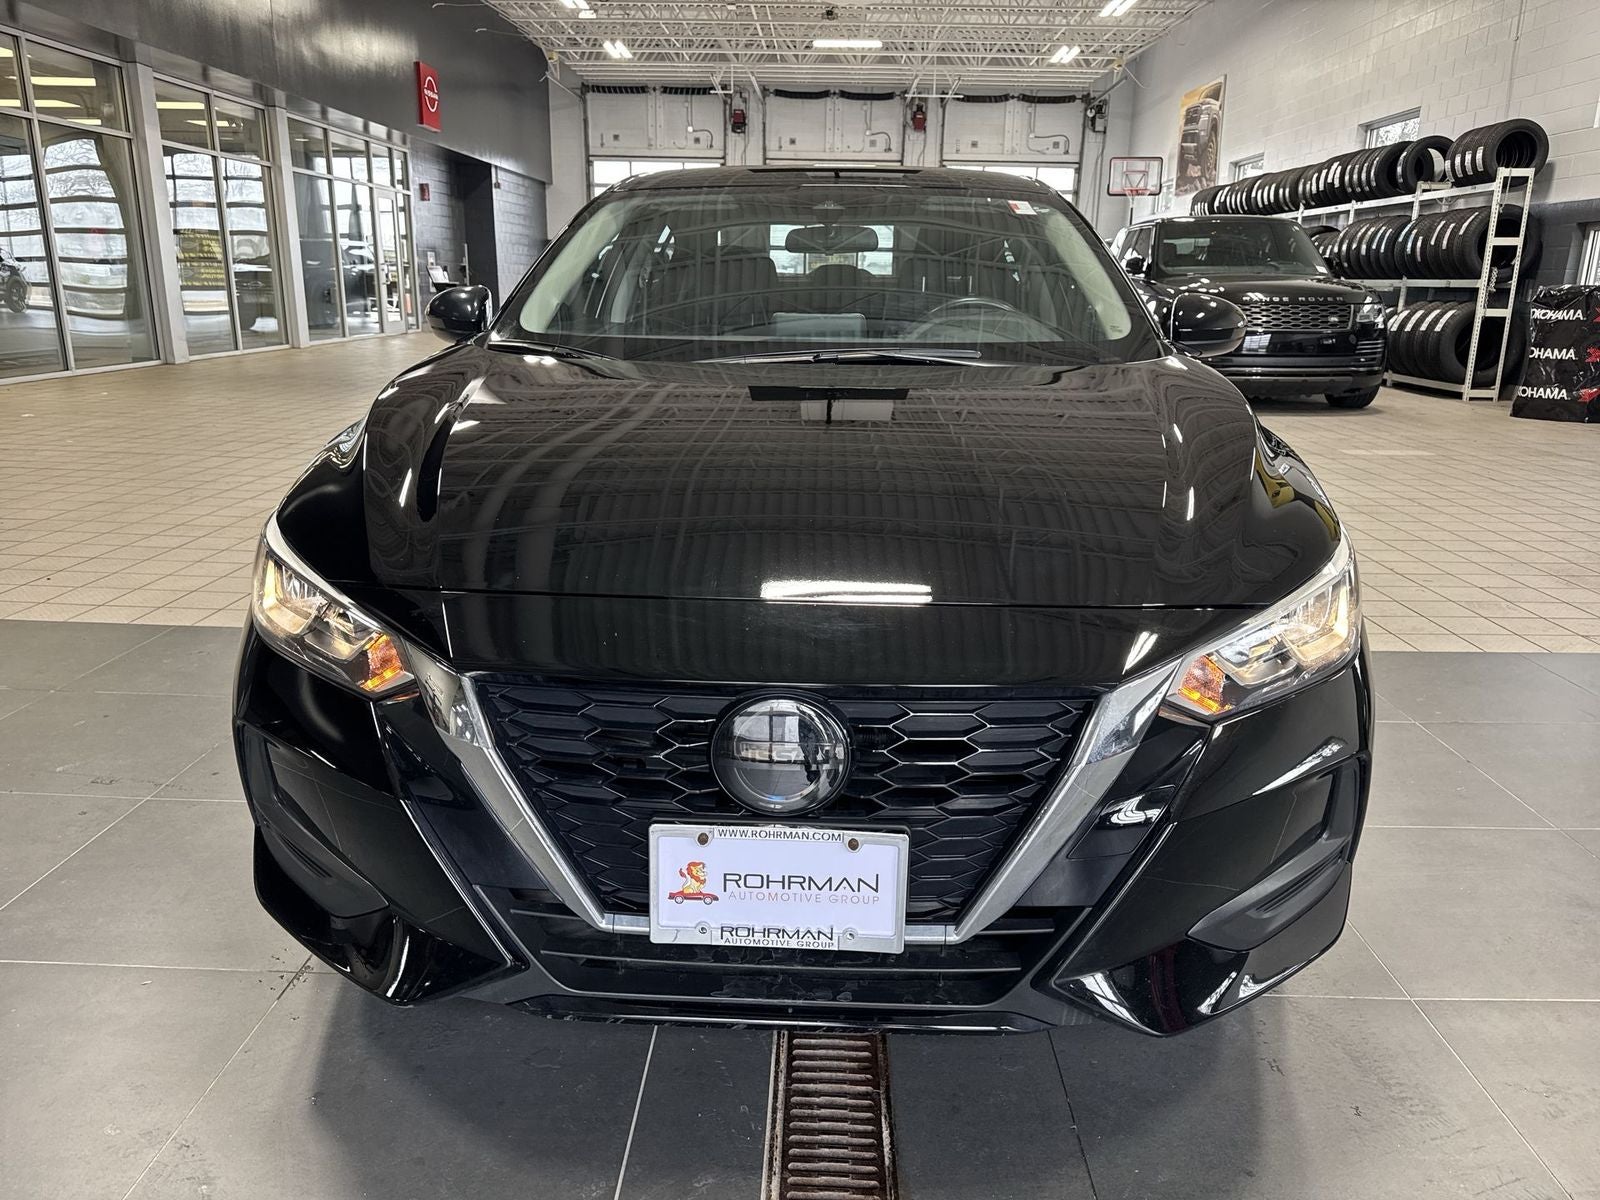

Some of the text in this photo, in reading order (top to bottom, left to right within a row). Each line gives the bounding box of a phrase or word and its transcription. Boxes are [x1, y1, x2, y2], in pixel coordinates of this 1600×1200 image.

[717, 828, 842, 842] WWW.ROHRMAN.COM
[723, 872, 879, 893] ROHRMAN
[728, 890, 880, 905] AUTOMOTIVE GROUP
[720, 925, 833, 941] ROHRMAN
[724, 936, 834, 949] AUTOMOTIVE GROUP
